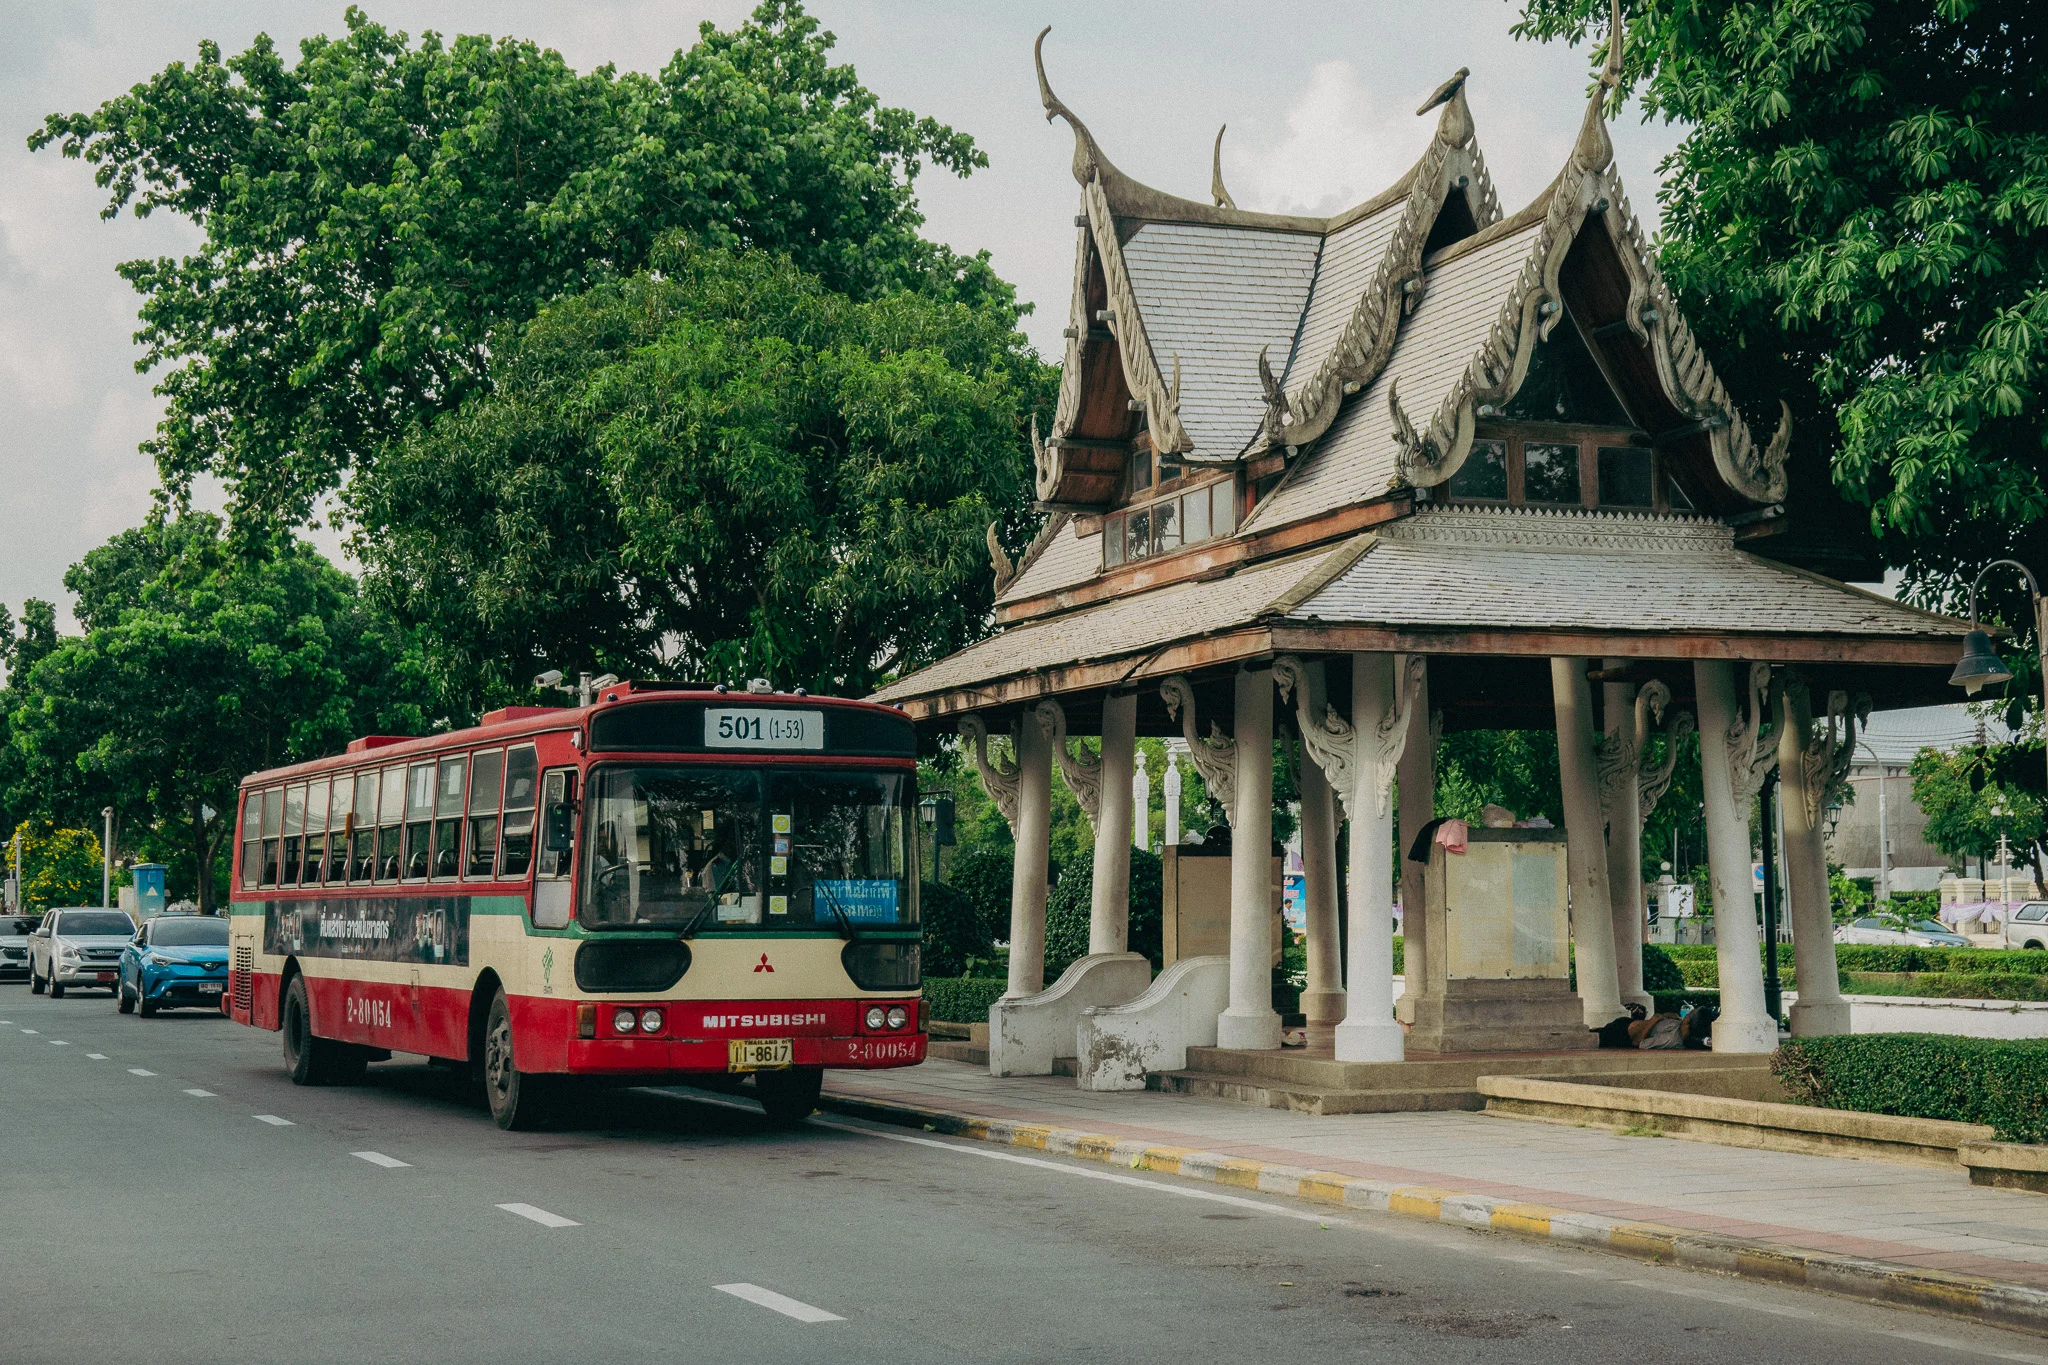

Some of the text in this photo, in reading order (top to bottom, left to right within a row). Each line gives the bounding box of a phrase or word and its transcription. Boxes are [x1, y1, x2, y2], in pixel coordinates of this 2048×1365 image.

[718, 715, 805, 742] 501 (1-53)
[347, 996, 392, 1028] 2-80054
[702, 1013, 826, 1029] MITSUBISHI
[735, 1045, 788, 1063] 11-8617
[848, 1041, 917, 1060] 2-80054
